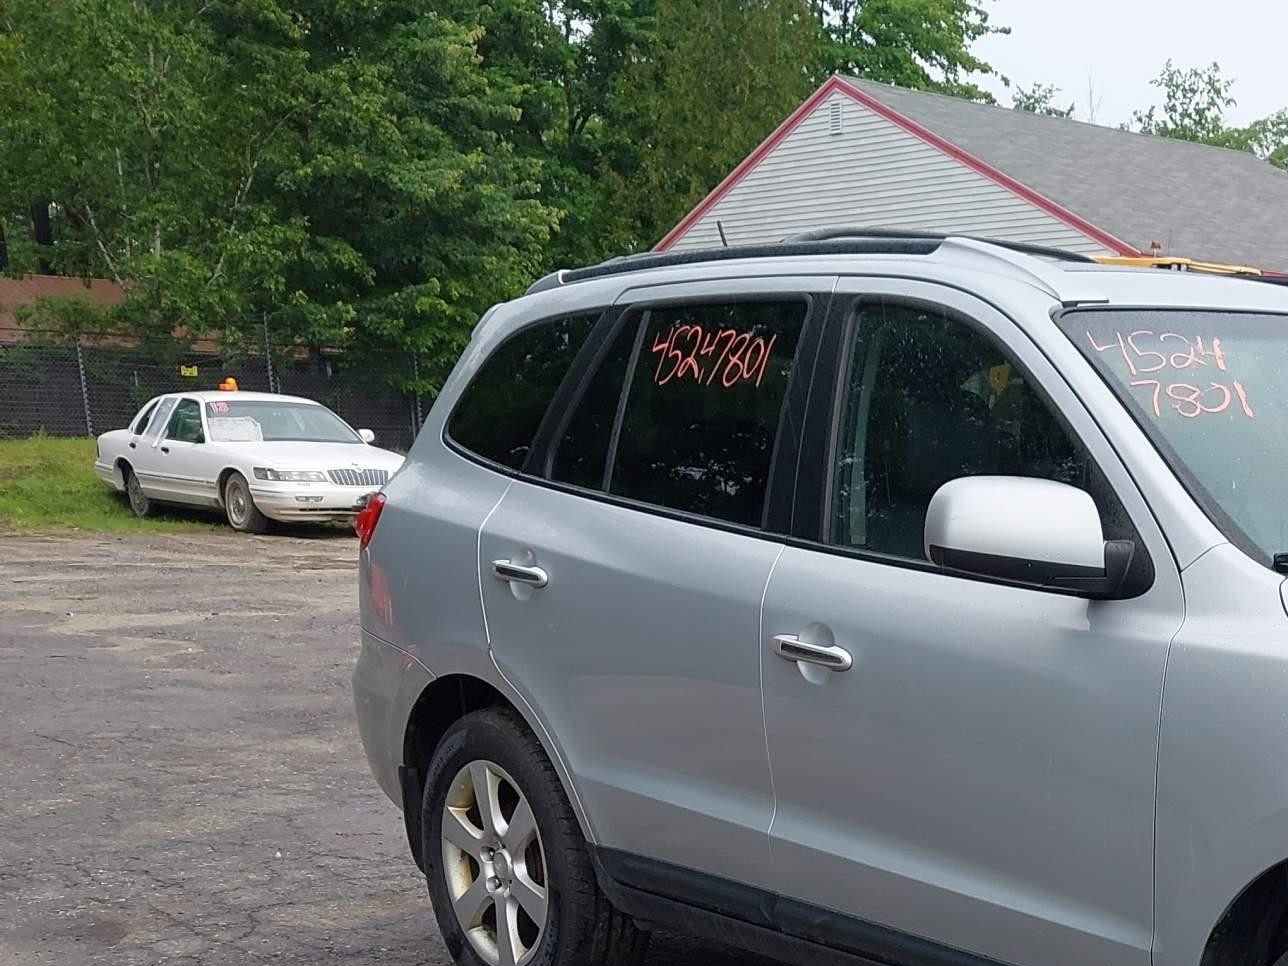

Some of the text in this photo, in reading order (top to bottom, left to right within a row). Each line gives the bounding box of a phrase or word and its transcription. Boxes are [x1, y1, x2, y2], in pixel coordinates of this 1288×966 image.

[652, 325, 777, 388] 45247801
[1086, 330, 1226, 375] 4524
[1129, 379, 1255, 419] 7801
